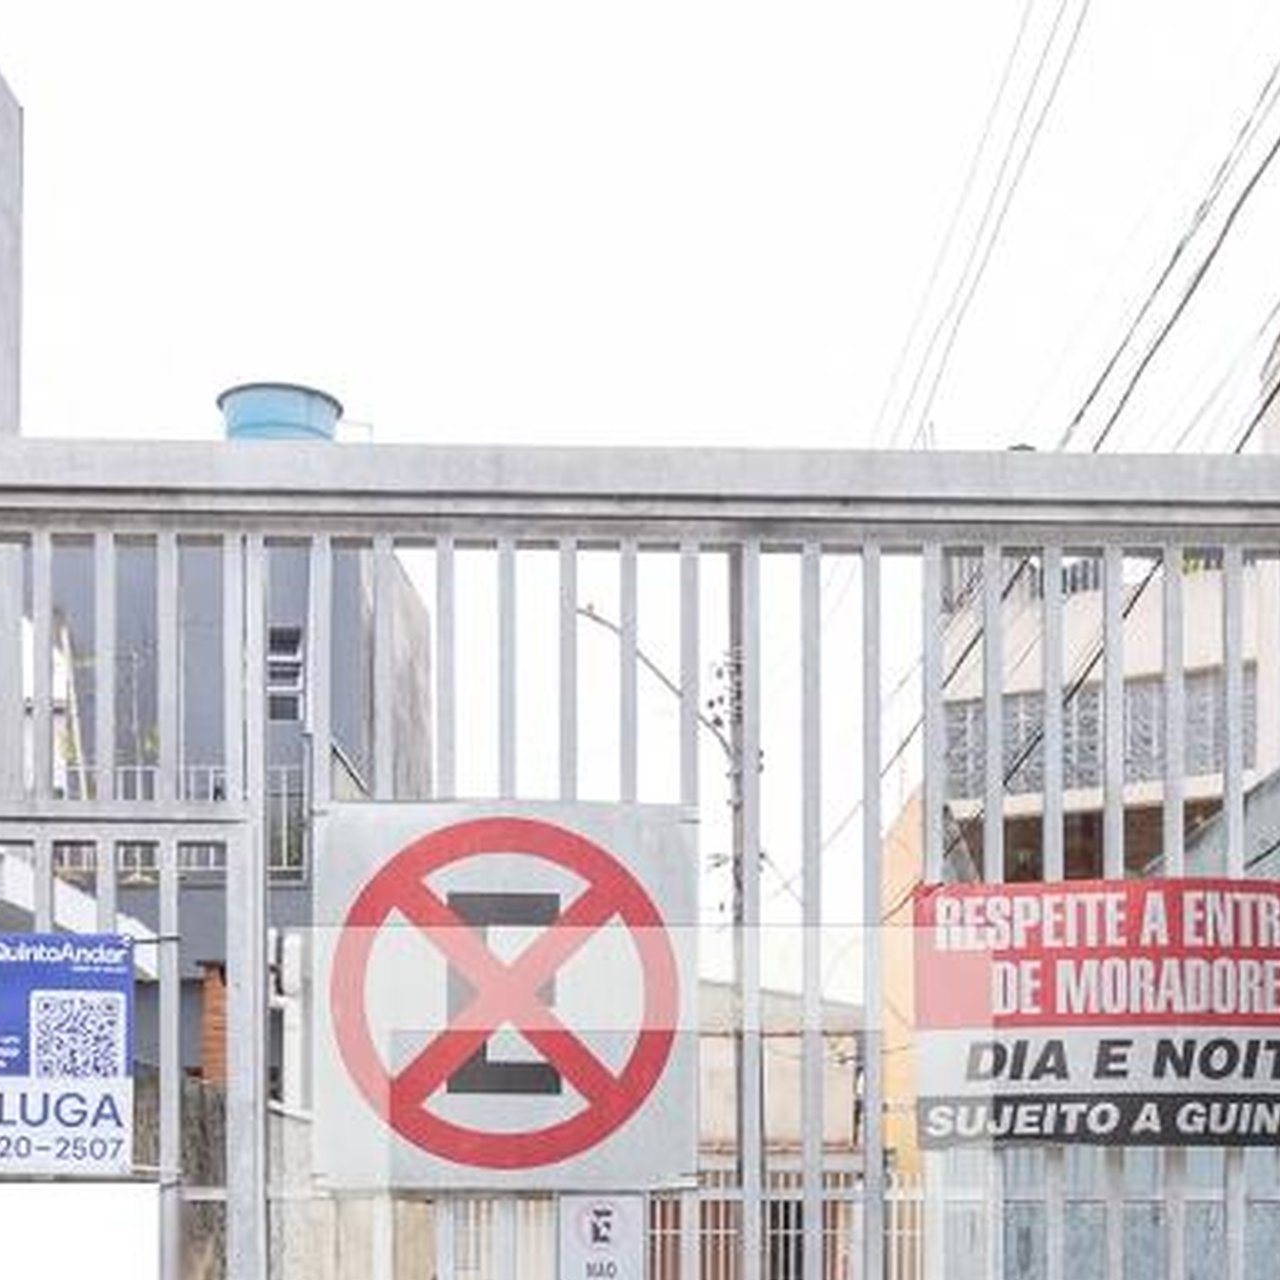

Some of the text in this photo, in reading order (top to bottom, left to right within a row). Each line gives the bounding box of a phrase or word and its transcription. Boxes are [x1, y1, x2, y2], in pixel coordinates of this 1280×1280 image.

[934, 891, 1127, 951] RESPEITE
[1140, 891, 1170, 948] A
[990, 959, 1042, 1016] DE
[965, 1039, 1071, 1082] DIA
[1093, 1039, 1134, 1081] E
[926, 1101, 1120, 1138] SUJEITO
[1131, 1102, 1164, 1134] A
